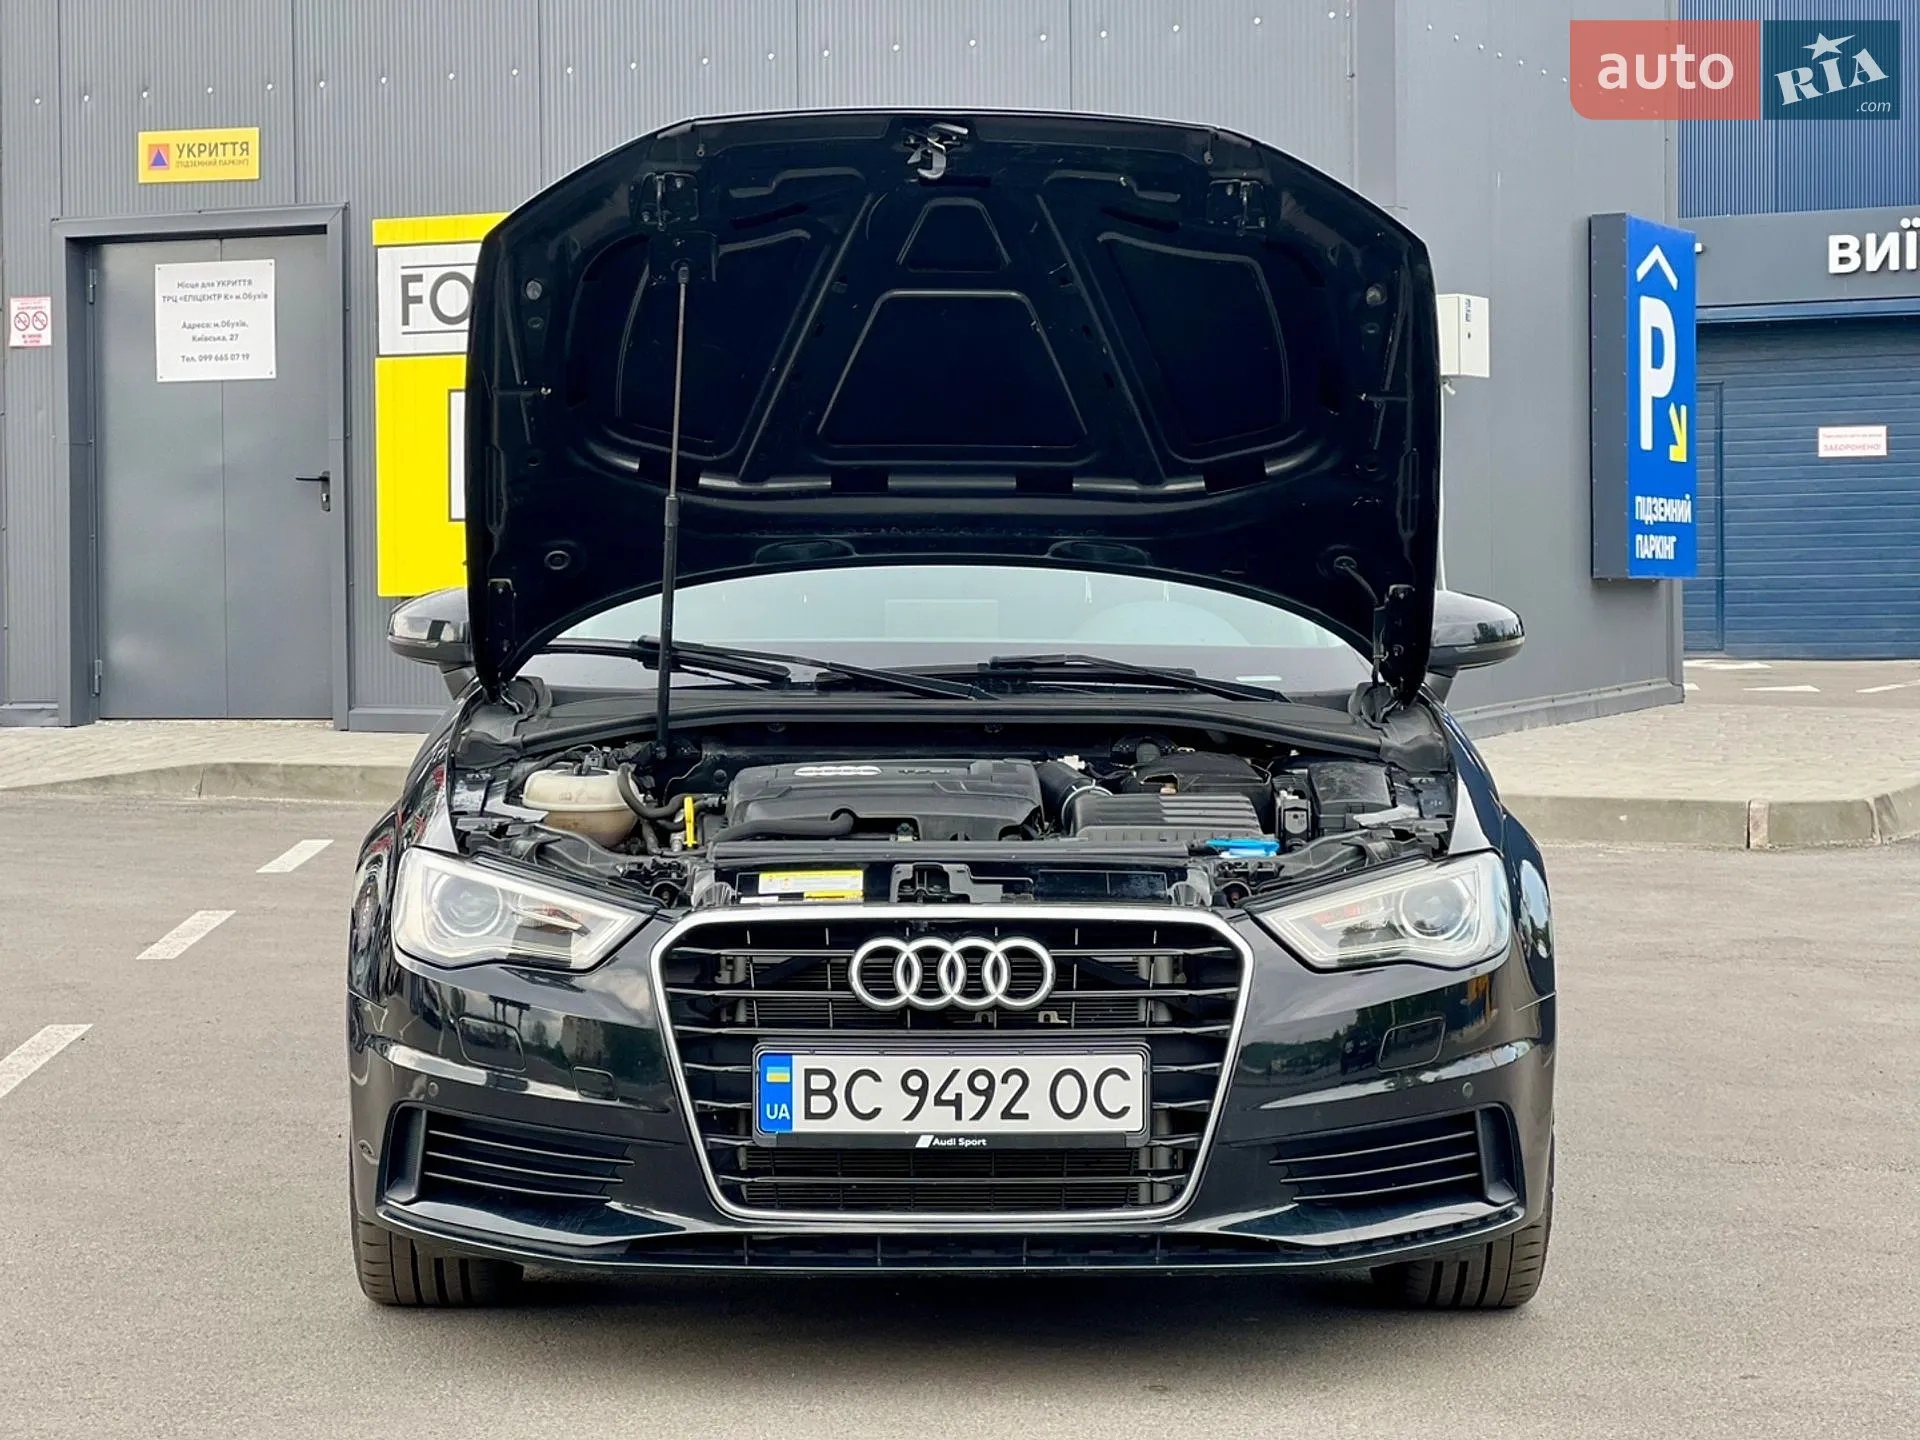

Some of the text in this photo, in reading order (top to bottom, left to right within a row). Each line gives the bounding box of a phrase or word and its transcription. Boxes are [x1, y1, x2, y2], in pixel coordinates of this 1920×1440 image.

[176, 141, 249, 159] УКРИТТЯ
[1828, 217, 1920, 275] ВИЇ
[216, 279, 253, 288] УКРИТТЯ
[162, 295, 178, 303] ТРЦ
[401, 271, 474, 326] FO
[229, 333, 240, 341] 27
[1639, 295, 1677, 451] P
[1635, 493, 1692, 525] ПІДЗЕМНИЙ
[1635, 534, 1677, 560] ПАРКІНГ
[804, 1068, 1131, 1121] BC 9492 OC
[767, 1104, 790, 1120] UA
[932, 1137, 987, 1148] Audi Sport
